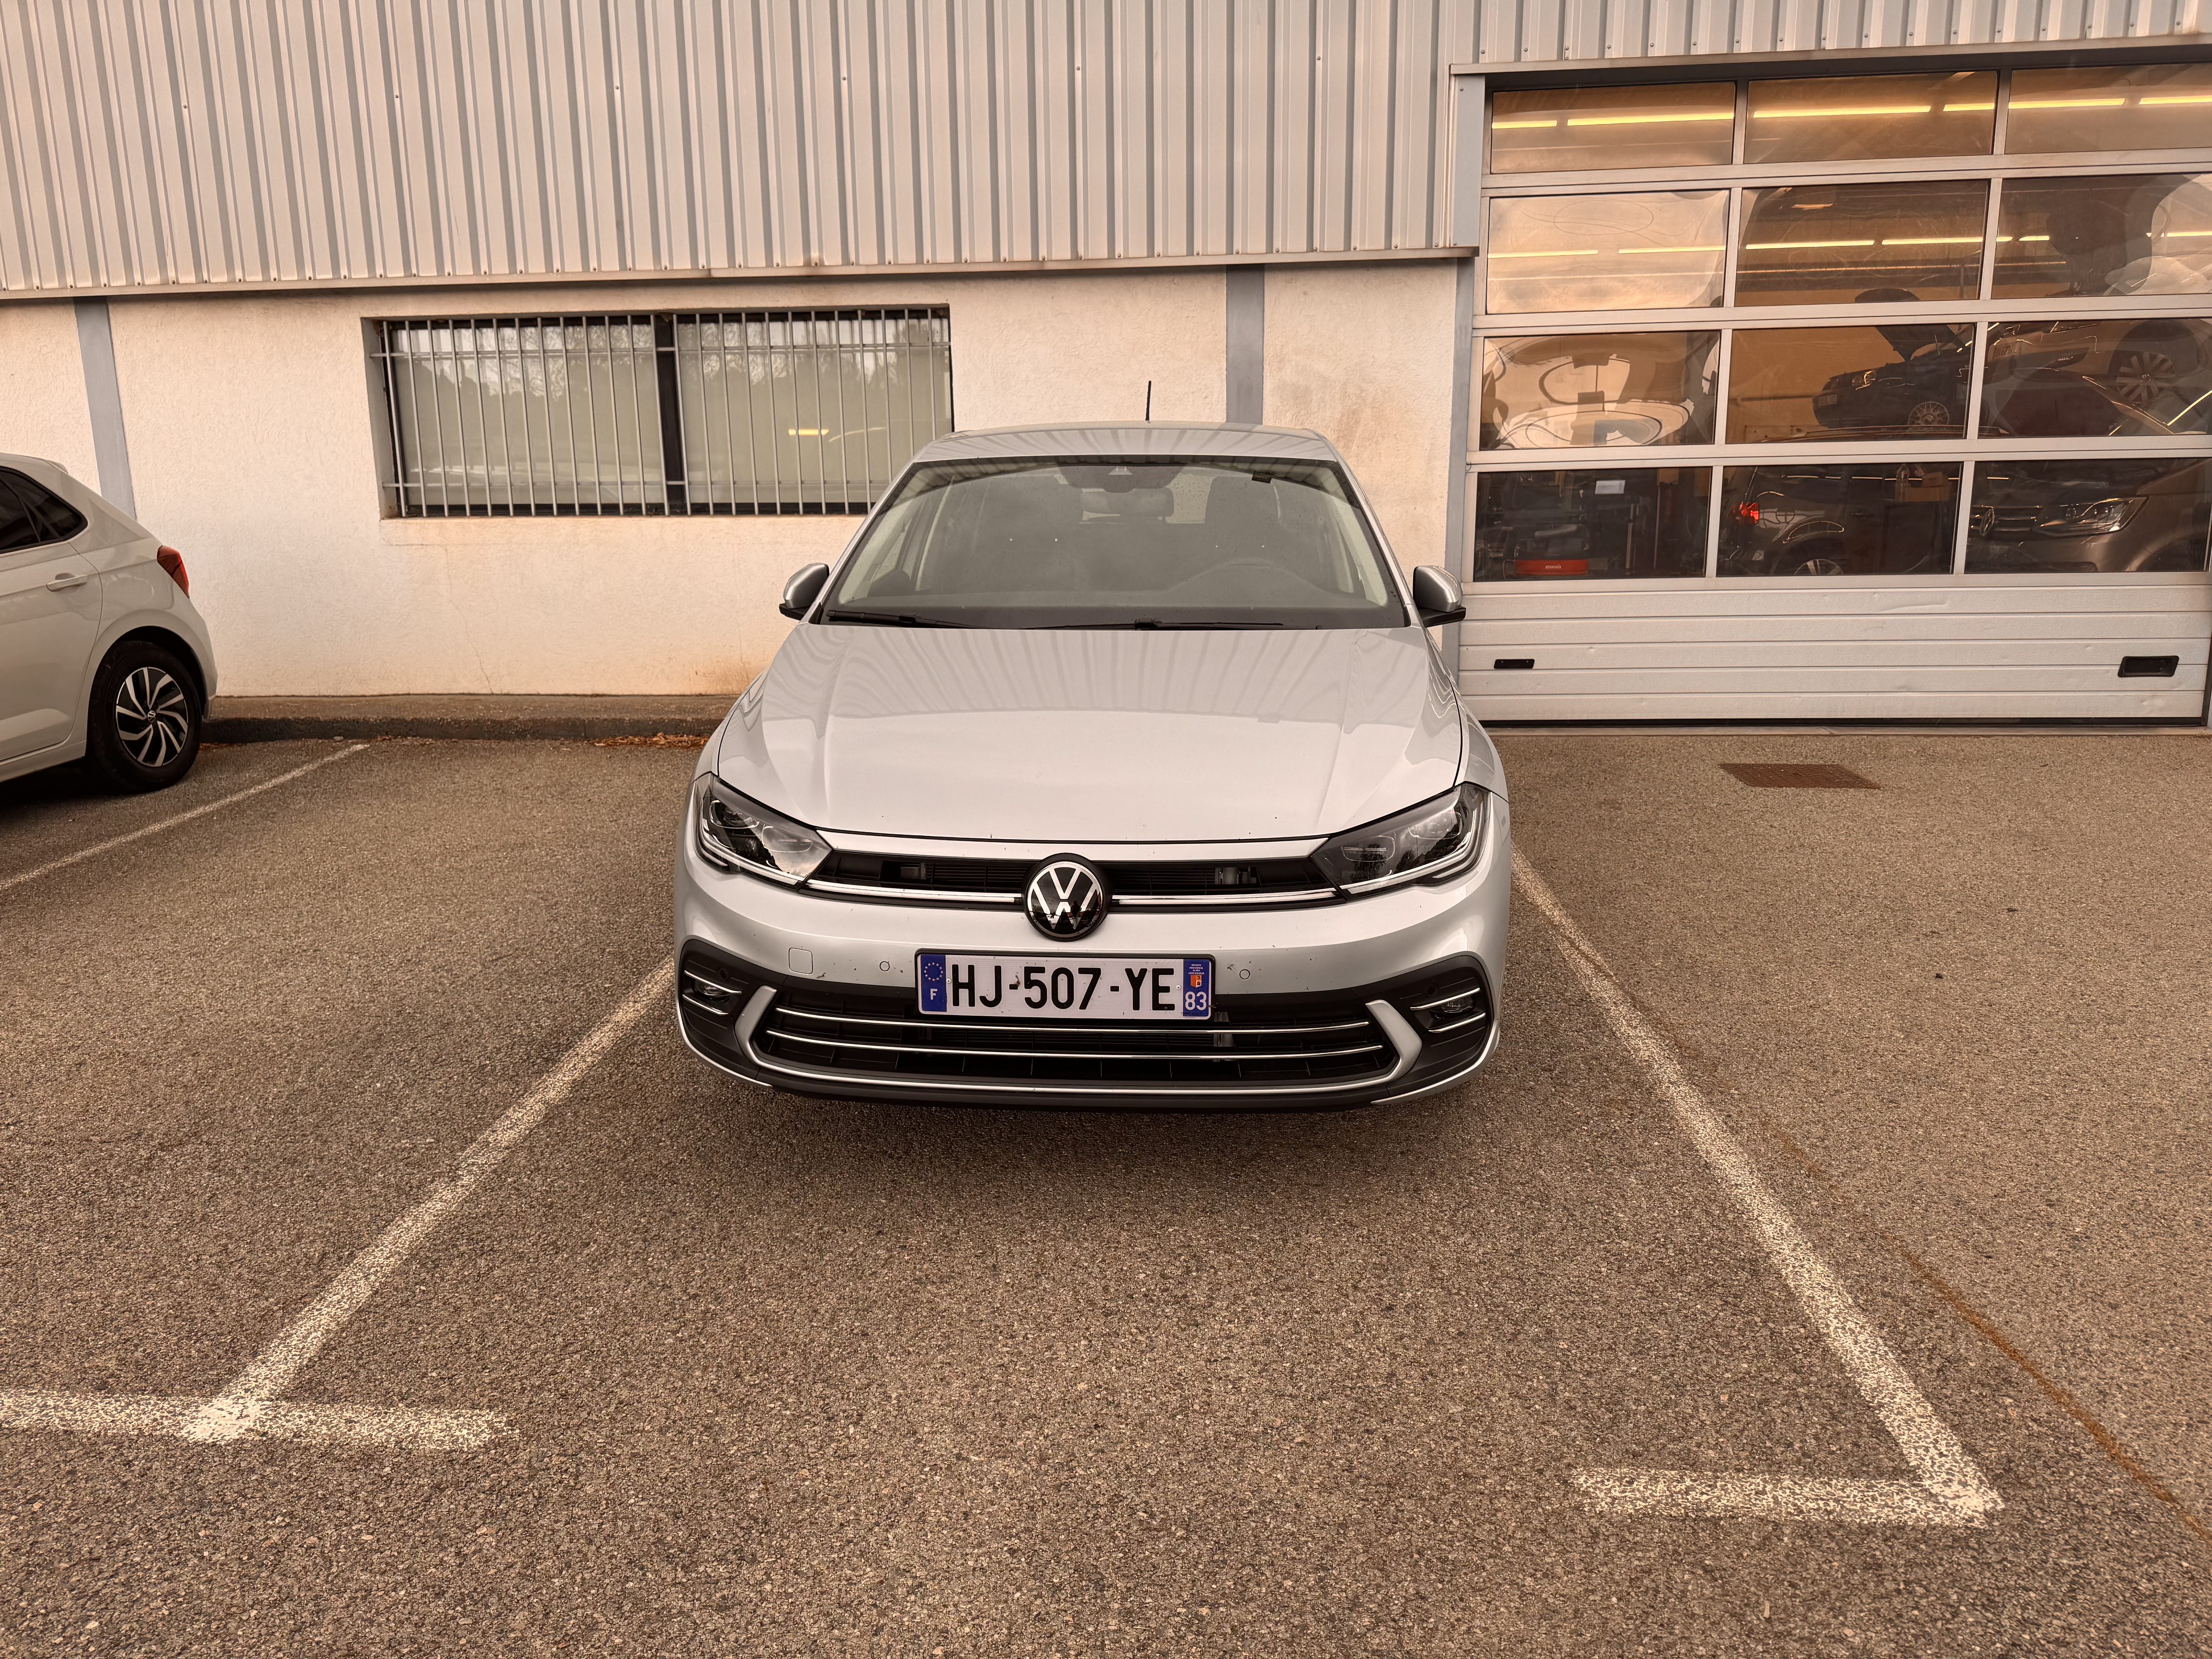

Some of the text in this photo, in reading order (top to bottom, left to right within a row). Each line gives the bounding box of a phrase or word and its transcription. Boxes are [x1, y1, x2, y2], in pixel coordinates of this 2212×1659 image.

[930, 989, 937, 1000] F
[951, 964, 1175, 1011] HJ-507-YE
[1185, 991, 1207, 1010] 83
